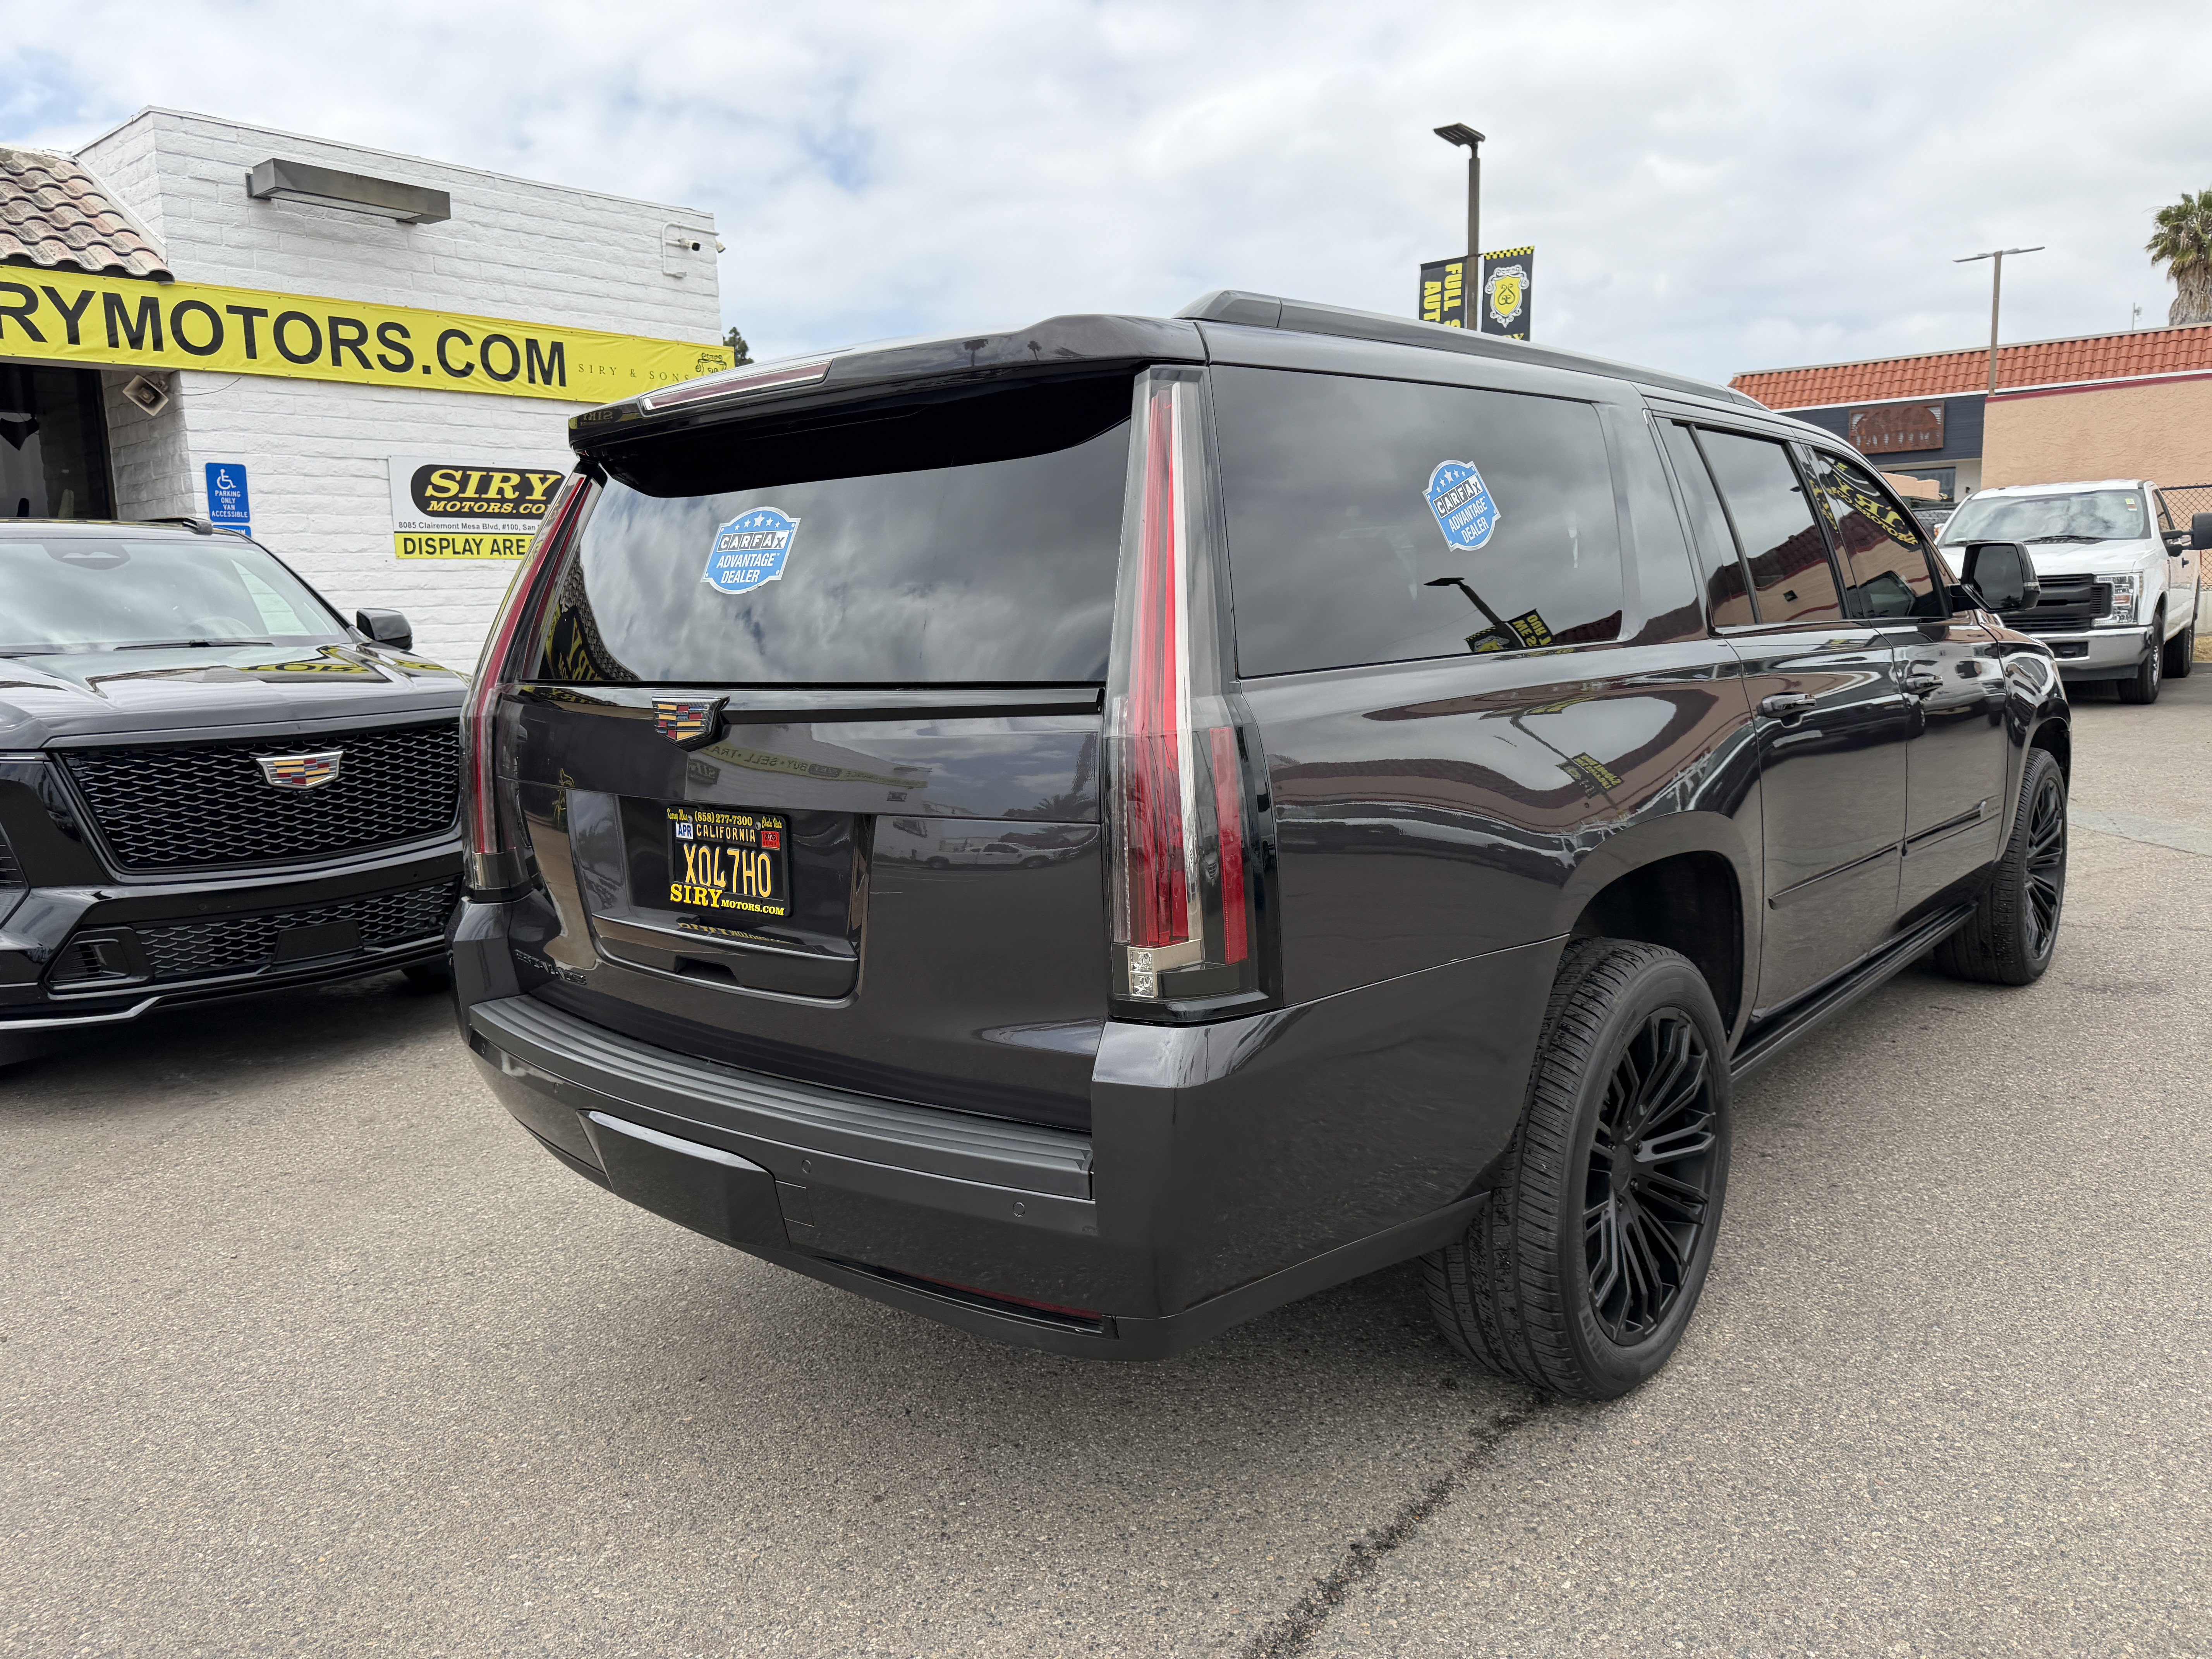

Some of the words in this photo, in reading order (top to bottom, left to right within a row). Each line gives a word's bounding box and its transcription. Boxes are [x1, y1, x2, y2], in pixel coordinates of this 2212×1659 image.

[1443, 263, 1463, 311] FULL
[579, 364, 617, 376] SIRY
[630, 369, 637, 378] &
[424, 469, 561, 500] SIRY
[1436, 479, 1482, 515] CARFAX
[1461, 517, 1489, 544] DEALER
[404, 537, 484, 555] DISPLAY
[490, 538, 532, 556] ARE
[720, 533, 787, 550] CARFAX
[721, 570, 760, 583] DEALER
[695, 811, 714, 823] (858)
[716, 813, 752, 826] 277-7300
[678, 823, 691, 837] APR
[696, 824, 756, 842] CALIFORNIA
[670, 883, 723, 908] SIRY
[721, 899, 785, 916] MOTORS.COM
